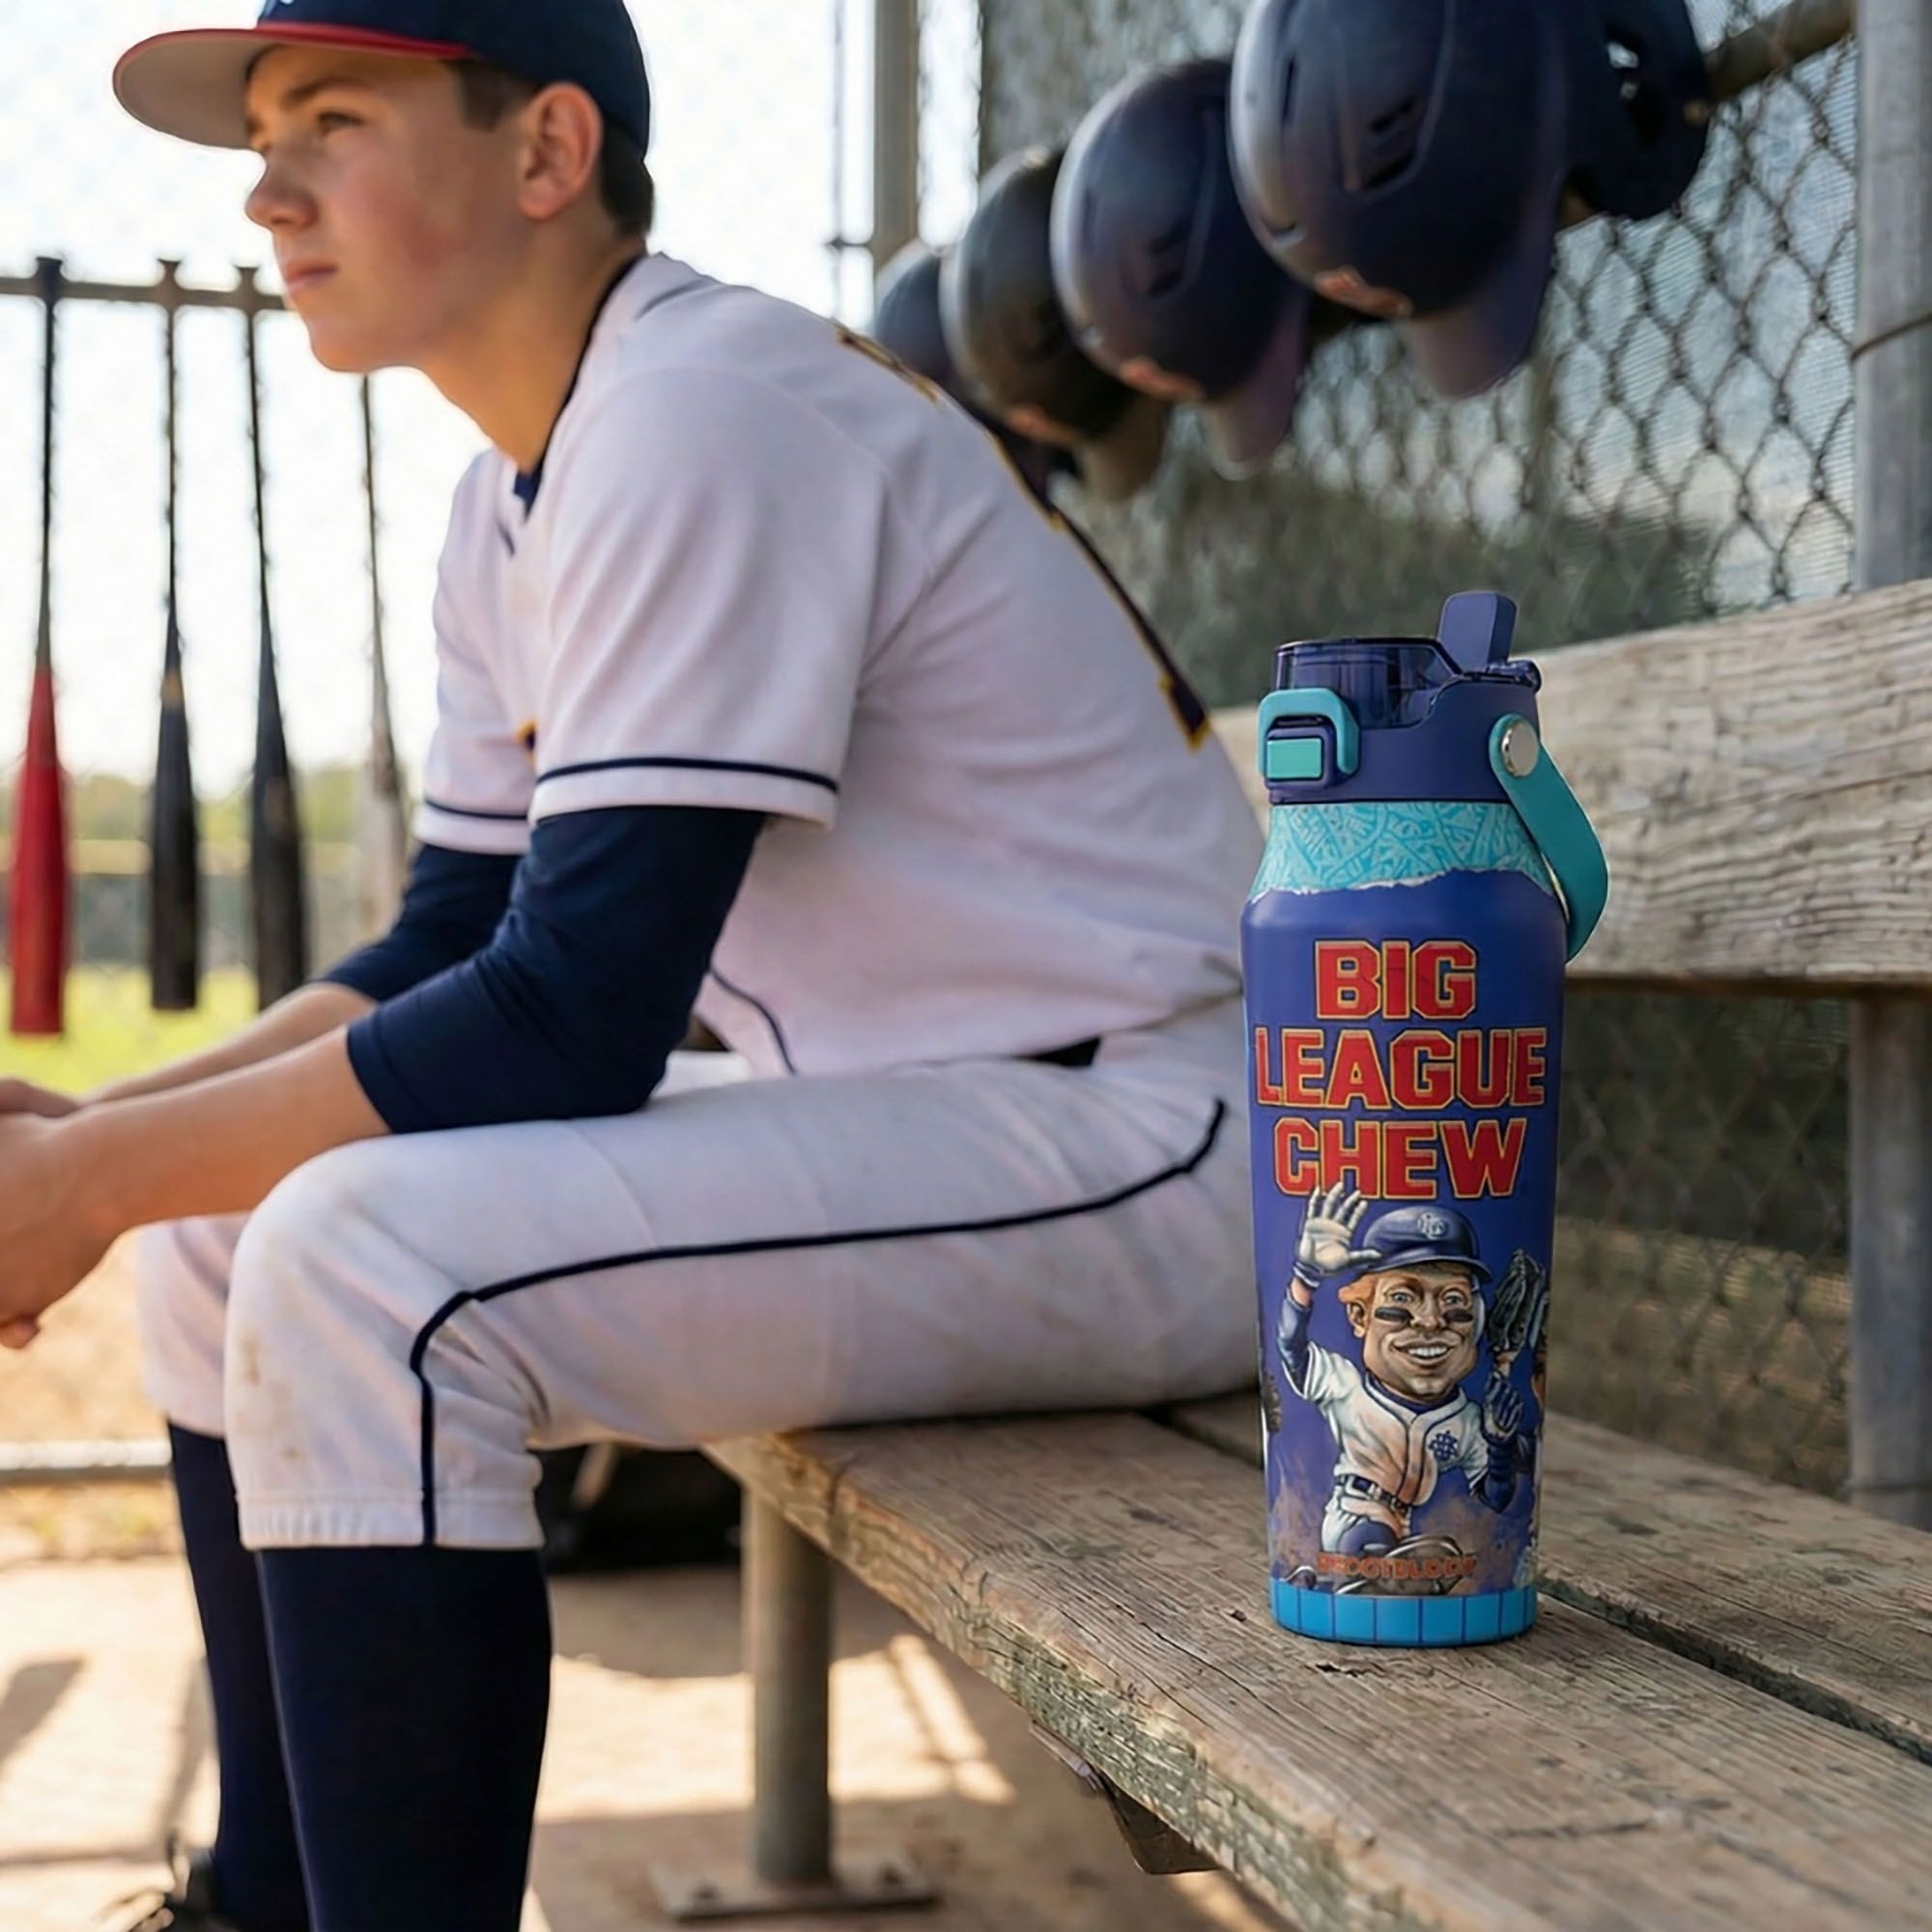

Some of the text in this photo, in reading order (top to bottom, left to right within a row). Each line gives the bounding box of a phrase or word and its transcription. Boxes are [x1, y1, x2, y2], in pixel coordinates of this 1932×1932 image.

[1315, 940, 1477, 1019] BIG
[1256, 1027, 1546, 1110] LEAGUE
[1274, 1117, 1527, 1200] CHEW
